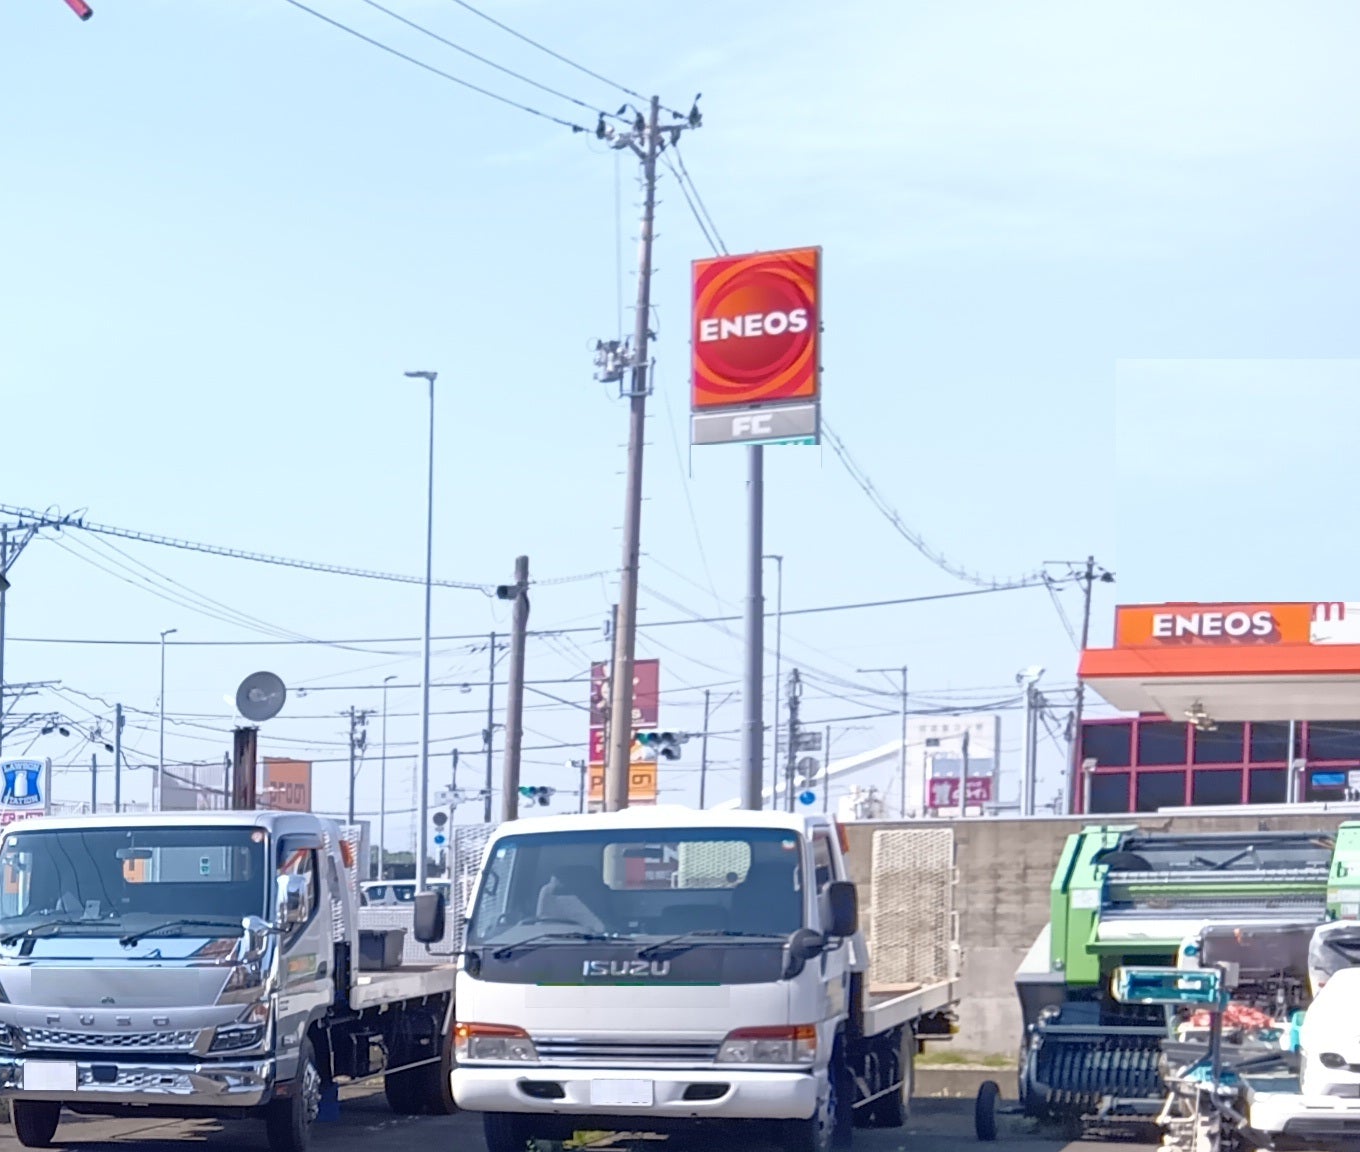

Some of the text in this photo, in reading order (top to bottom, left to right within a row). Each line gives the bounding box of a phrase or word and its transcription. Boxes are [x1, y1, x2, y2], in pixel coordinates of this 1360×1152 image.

[699, 308, 809, 342] ENEOS
[731, 414, 773, 437] FC
[1152, 610, 1273, 638] ENEOS
[582, 960, 671, 976] ISUZU
[46, 1013, 170, 1027] FUSO
